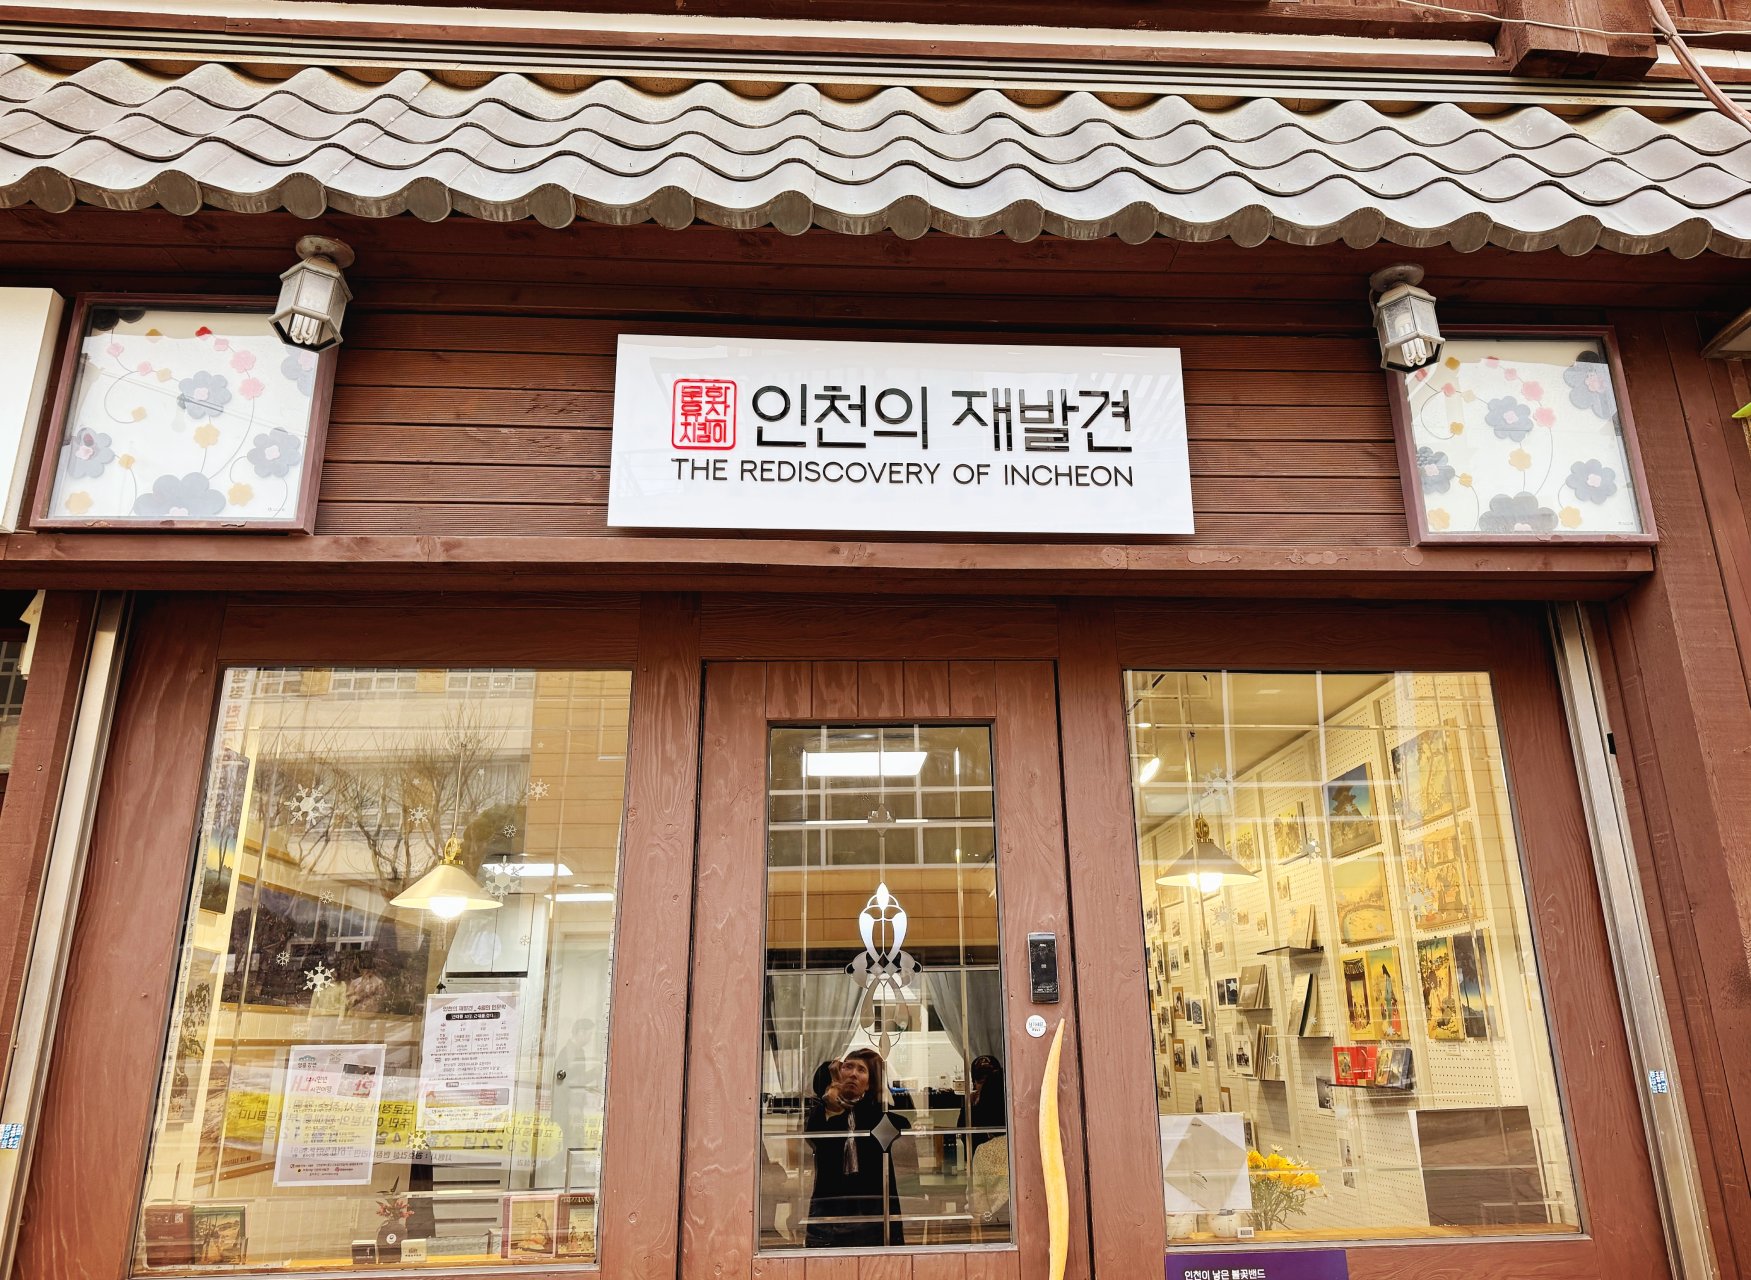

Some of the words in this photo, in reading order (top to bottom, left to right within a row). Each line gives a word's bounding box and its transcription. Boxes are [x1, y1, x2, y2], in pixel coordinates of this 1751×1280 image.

[751, 383, 929, 450] 인천의
[951, 387, 1133, 453] 재발견
[671, 458, 728, 481] THE
[740, 460, 941, 485] REDISCOVERY
[953, 463, 991, 486] OF
[1004, 464, 1133, 487] INCHEON
